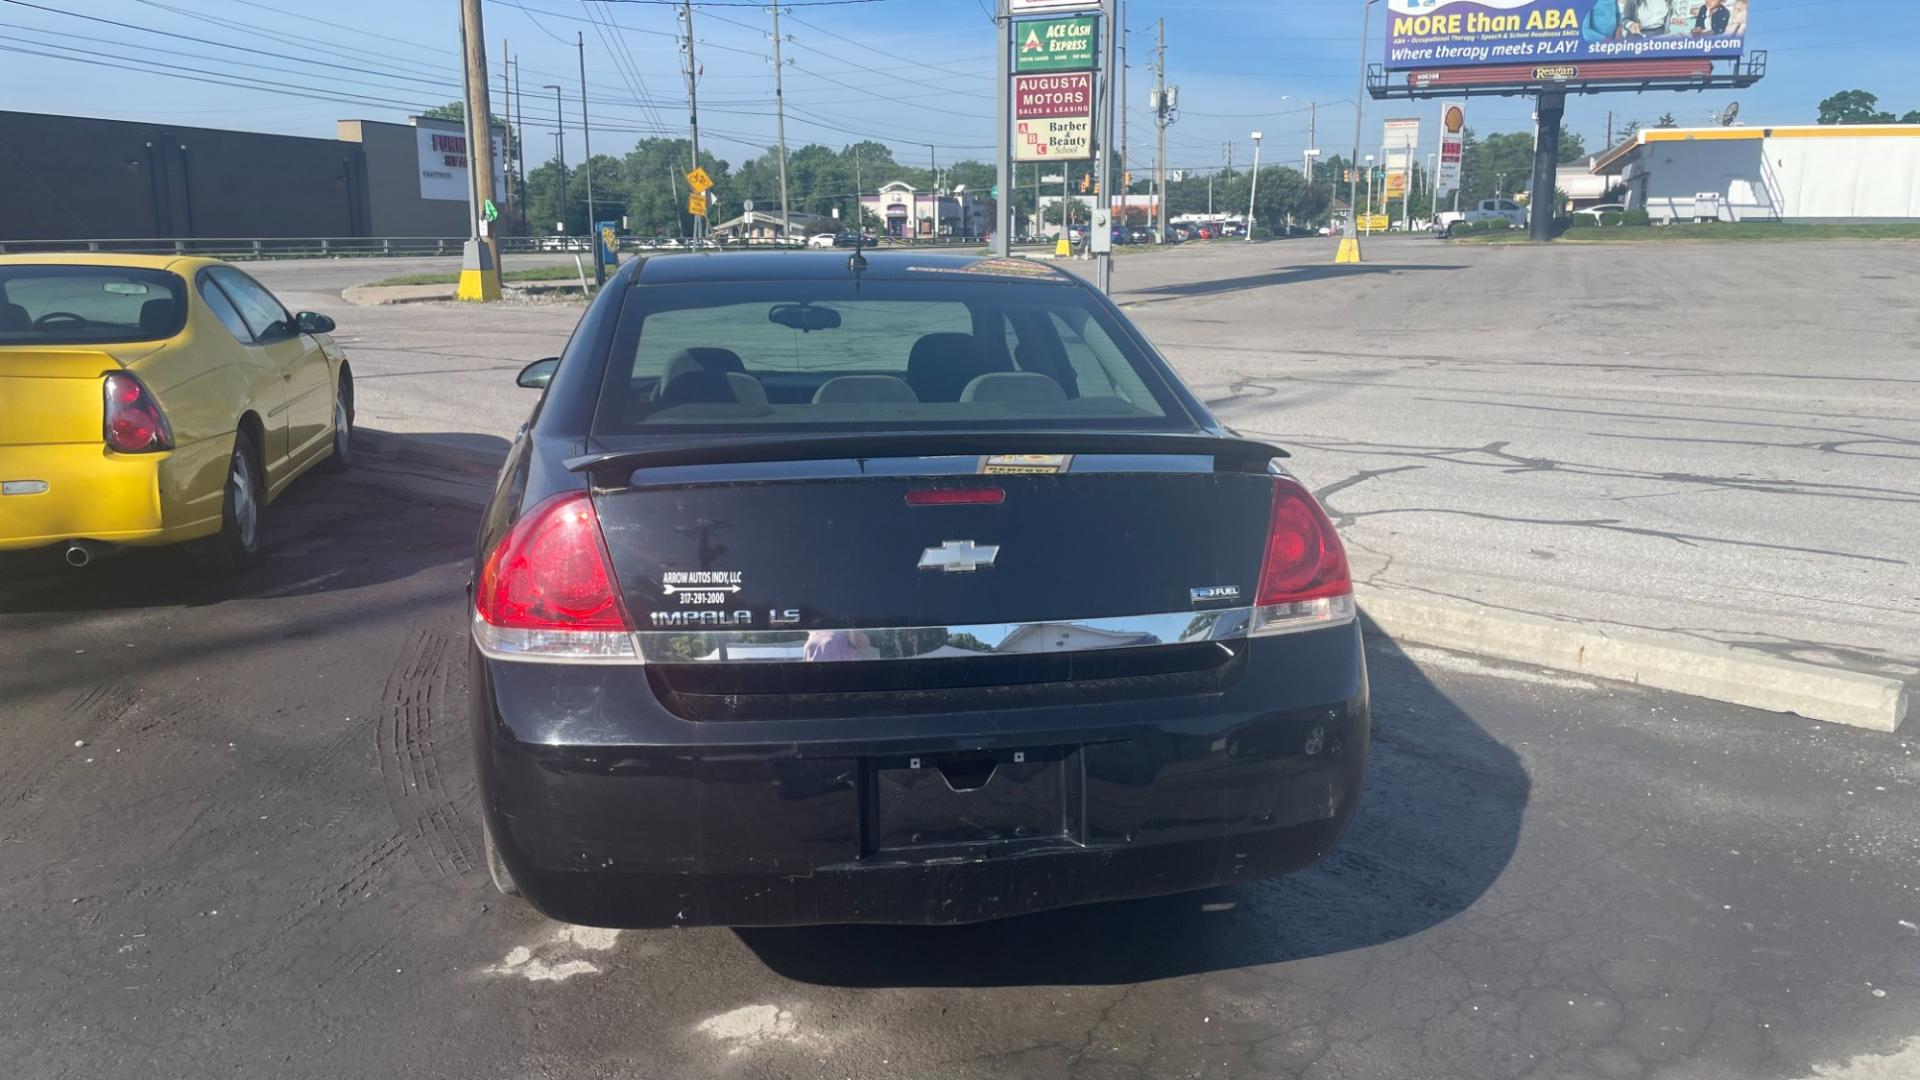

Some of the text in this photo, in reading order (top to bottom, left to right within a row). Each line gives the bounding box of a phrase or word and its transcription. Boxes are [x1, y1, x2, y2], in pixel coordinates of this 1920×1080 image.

[1393, 8, 1579, 37] MORE than ABA
[1046, 24, 1091, 38] ACE CASH
[1451, 34, 1475, 42] Therapy
[1481, 32, 1502, 40] Speech
[1509, 31, 1530, 39] School
[1049, 40, 1087, 52] EXPRESS
[1391, 39, 1579, 61] Where therapy meets PLAY!
[1588, 37, 1741, 55] steppingstonesindy.com
[1535, 66, 1574, 80] Reagan
[1019, 77, 1088, 91] AUGUSTA
[1023, 92, 1084, 105] MOTORS
[1018, 107, 1043, 115] SALES
[1049, 121, 1088, 132] Barber
[1049, 136, 1087, 147] Beauty
[1055, 145, 1078, 153] School
[663, 571, 742, 585] ARROW AUTOS INDY, LLC
[679, 592, 725, 604] 317-291-2000
[650, 609, 801, 626] IMPALA LS
